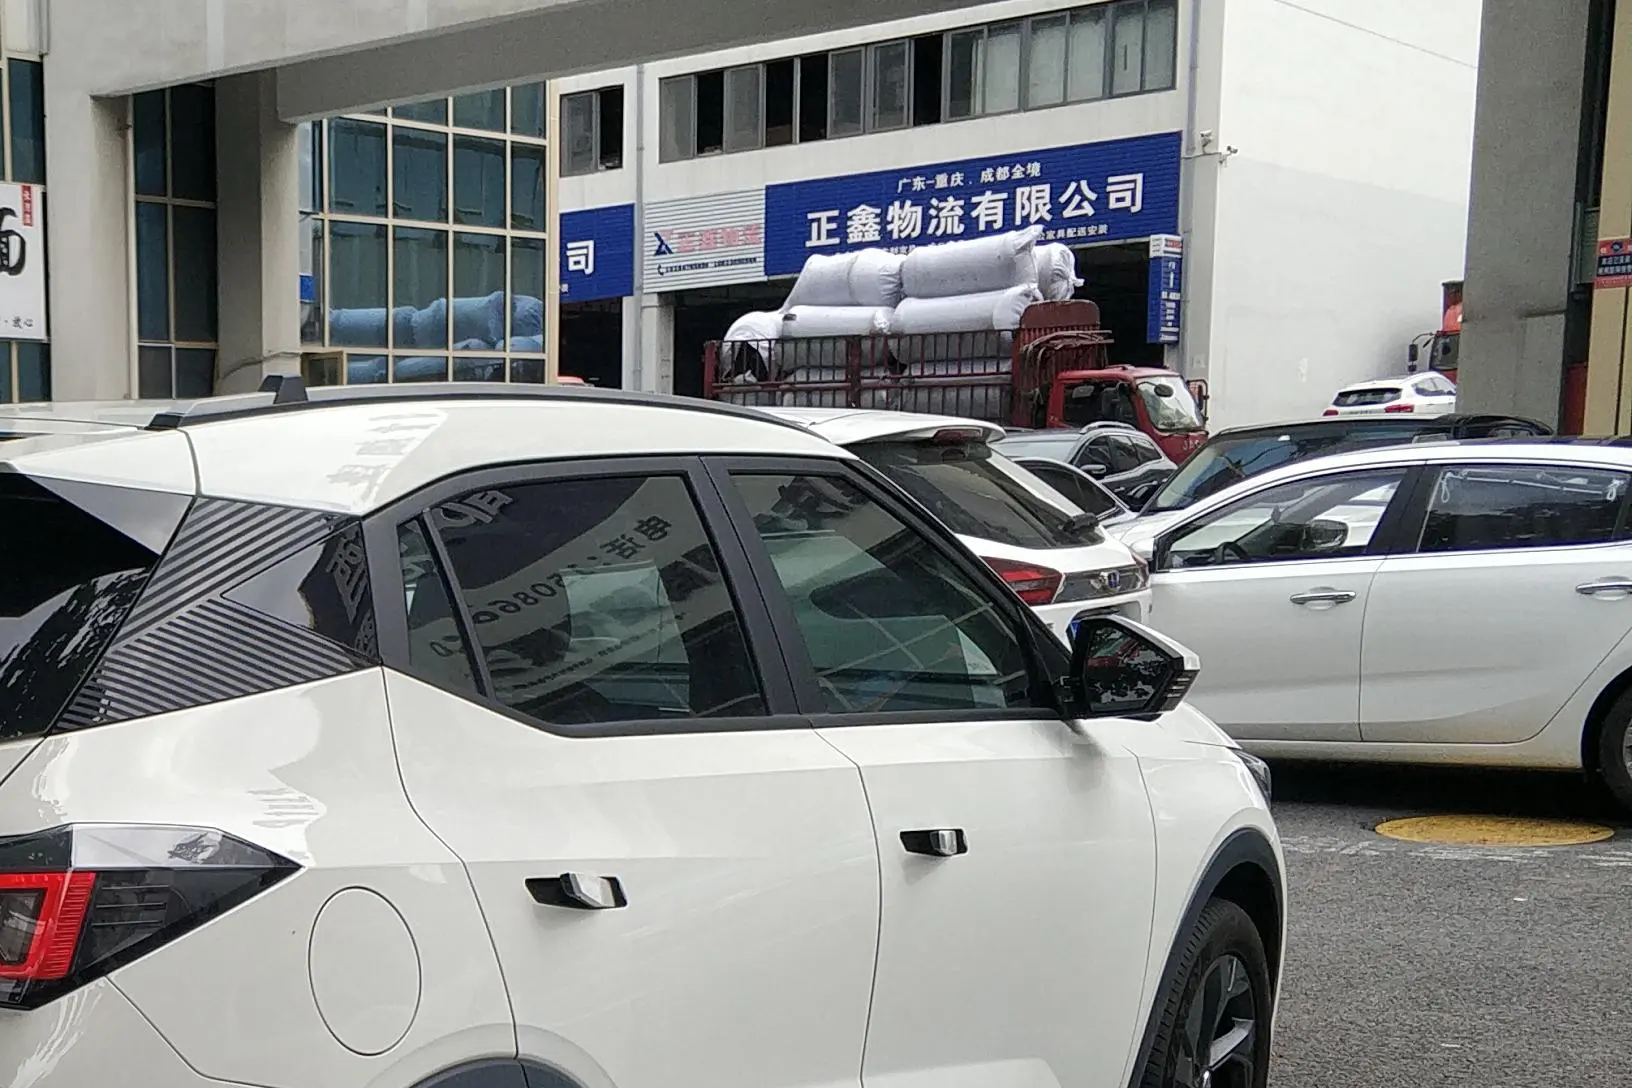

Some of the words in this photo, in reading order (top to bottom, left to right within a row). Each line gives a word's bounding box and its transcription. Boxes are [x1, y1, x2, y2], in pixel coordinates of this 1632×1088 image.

[805, 172, 1144, 248] 正鑫物流有限公司
[566, 240, 595, 275] 司
